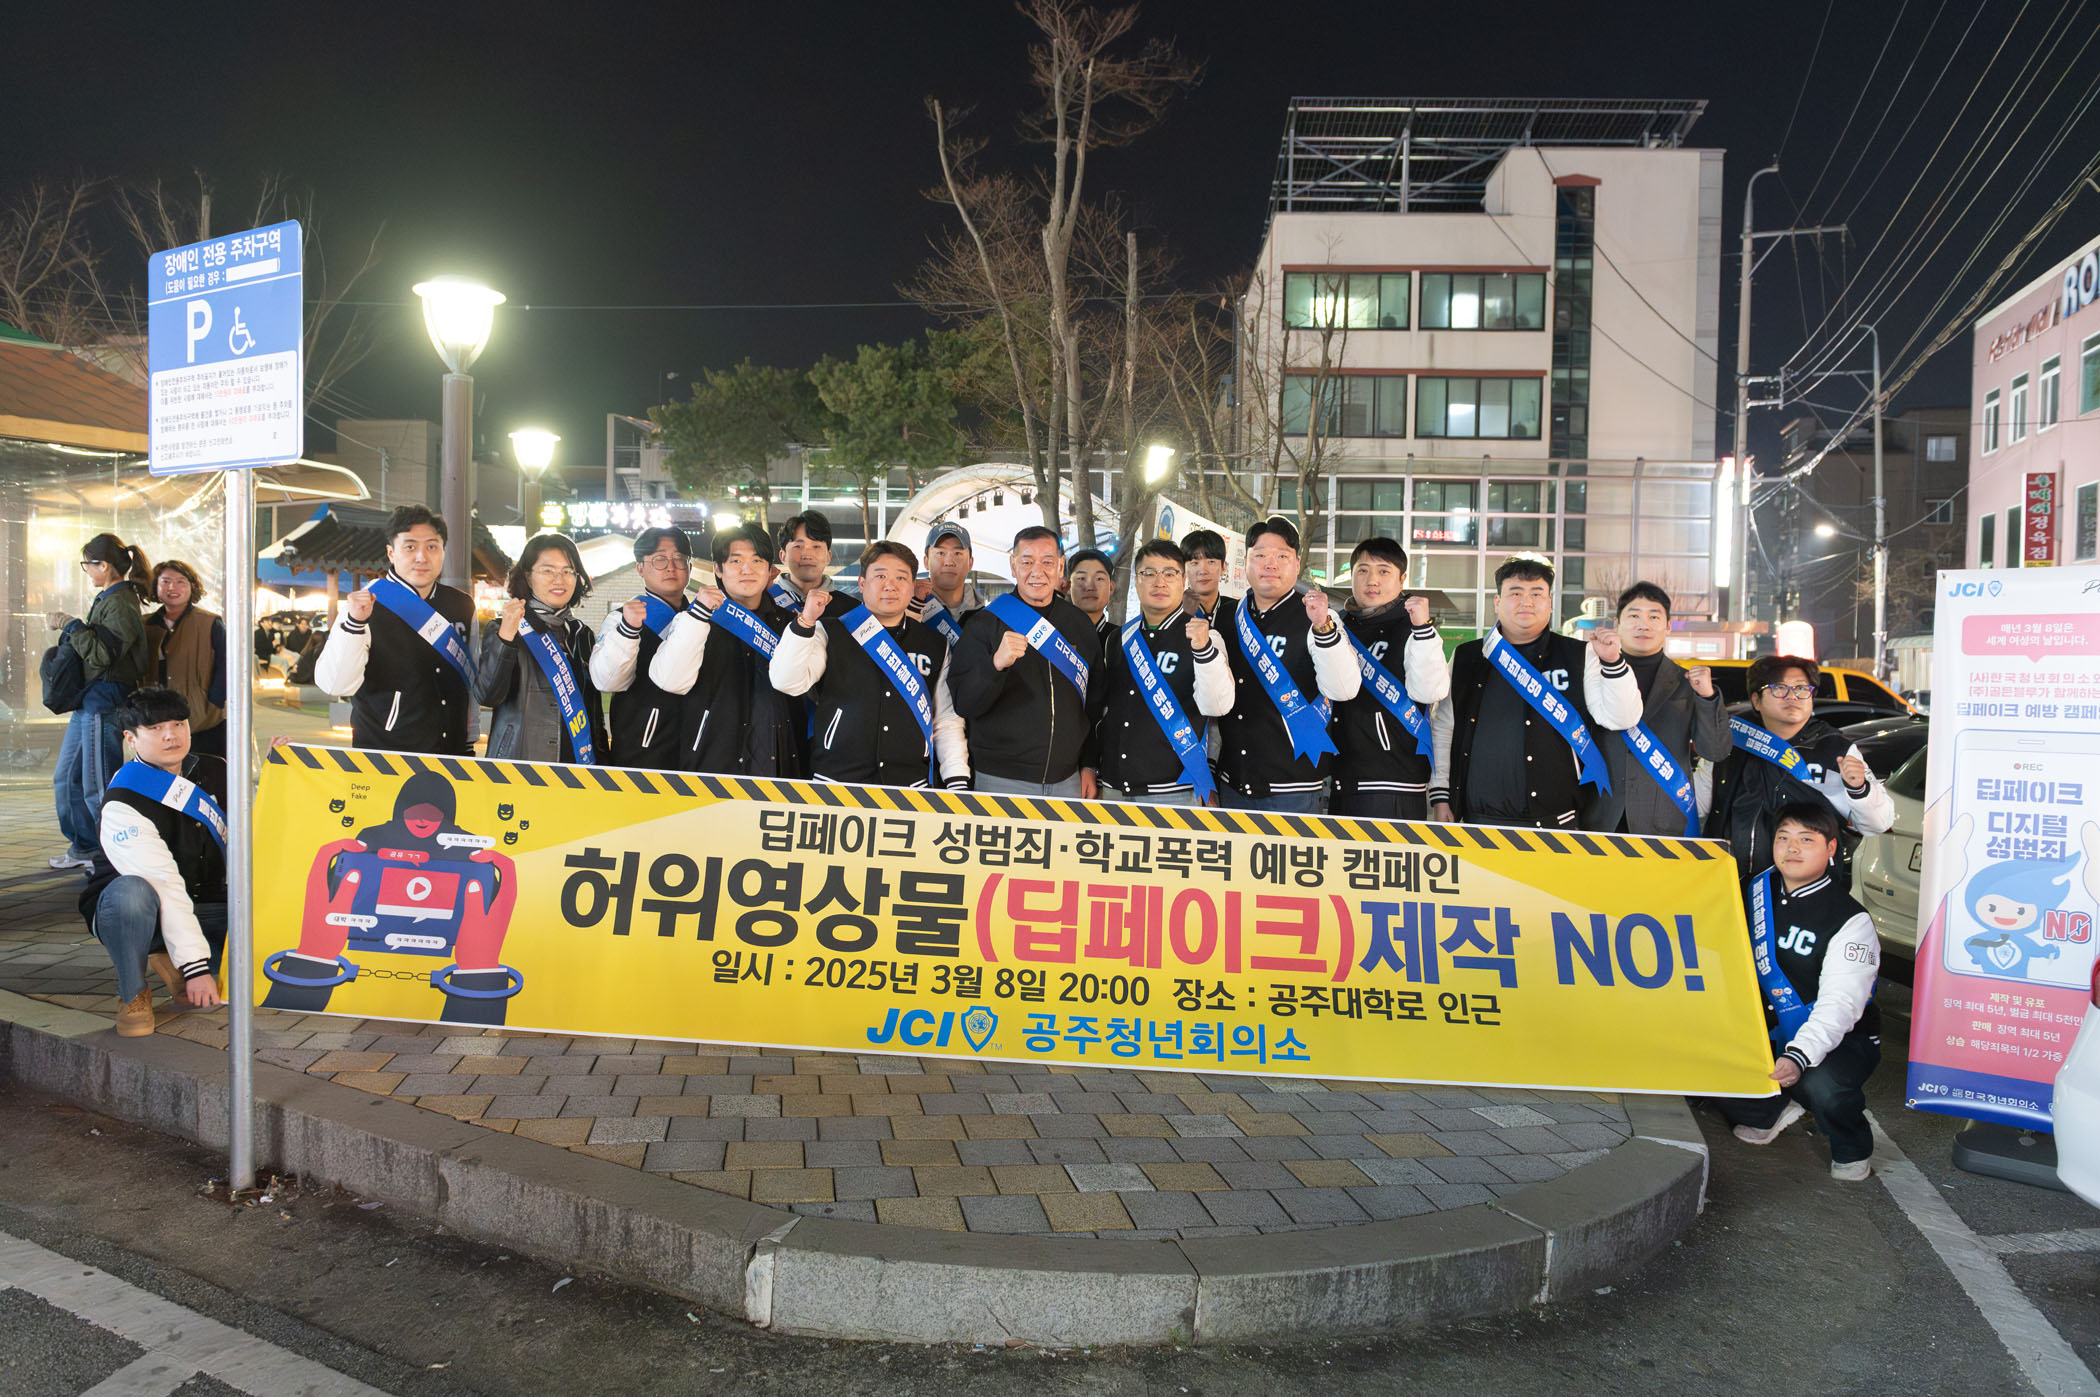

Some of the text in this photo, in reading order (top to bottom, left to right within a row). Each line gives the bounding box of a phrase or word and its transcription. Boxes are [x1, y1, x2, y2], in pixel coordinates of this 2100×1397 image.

[165, 229, 280, 276] 장애인 전용 주차구역
[165, 278, 185, 295] (도움이
[187, 274, 205, 290] 필요한
[207, 270, 220, 286] 경우
[2063, 247, 2100, 320] RO
[187, 299, 213, 363] P
[1948, 582, 1984, 597] JCI
[937, 619, 960, 647] 불법
[1032, 630, 1044, 644] JCI
[2024, 623, 2042, 634] 3월
[753, 634, 775, 658] 딥페
[1237, 607, 1261, 658] 불법촬영
[1258, 653, 1280, 685] 예방
[1367, 641, 1389, 661] C
[541, 633, 576, 695] 디지털성범죄
[1055, 637, 1088, 684] 디지털성범
[876, 640, 932, 726] 불법촬영 예방
[1129, 638, 1157, 691] 불법촬영
[1153, 687, 1175, 720] 예방
[1375, 674, 1400, 704] 예방
[1498, 649, 1568, 723] 불법촬영 예방
[569, 709, 587, 738] NO
[1957, 702, 2100, 720] 딥페이크 예방 캠페
[1649, 749, 1674, 781] 예방
[1778, 747, 1801, 770] NO
[2022, 763, 2044, 772] REC
[351, 783, 371, 791] Deep
[1977, 778, 2083, 805] 딥페이크
[1988, 811, 2067, 838] 디지털
[759, 810, 916, 858] 딥페이크
[1250, 842, 1328, 887] 예방
[1342, 848, 1460, 894] 캠페인
[1986, 836, 2066, 863] 성범죄
[1752, 877, 1772, 976] 불법촬영 예방
[1778, 925, 1816, 956] JC
[2043, 909, 2092, 944] NO
[1551, 912, 1705, 991] NO!
[711, 950, 773, 986] 일시
[804, 956, 918, 995] 2025년
[931, 964, 982, 999] 3월
[994, 968, 1046, 1001] 8일
[1059, 972, 1150, 1006] 20:00
[1173, 978, 1236, 1012] 장소
[1268, 984, 1427, 1021] 공주대학로
[1438, 991, 1500, 1026] 인근
[1989, 992, 2010, 1003] 제작
[2025, 997, 2045, 1008] 유포
[1965, 1001, 1984, 1013] 최대
[2010, 1007, 2029, 1019] 벌금
[2032, 1010, 2052, 1022] 최대
[866, 1008, 955, 1048] JCI
[1022, 1012, 1311, 1064] 공주청년회의소
[1972, 1021, 2060, 1043] 판매 징역 최대 5년
[1945, 1035, 1965, 1047] 상습
[2023, 1048, 2039, 1058] 1/2
[2042, 1050, 2063, 1062] 가중
[1918, 1082, 1938, 1094] JCI
[1964, 1090, 2038, 1111] 한국청년회의소
